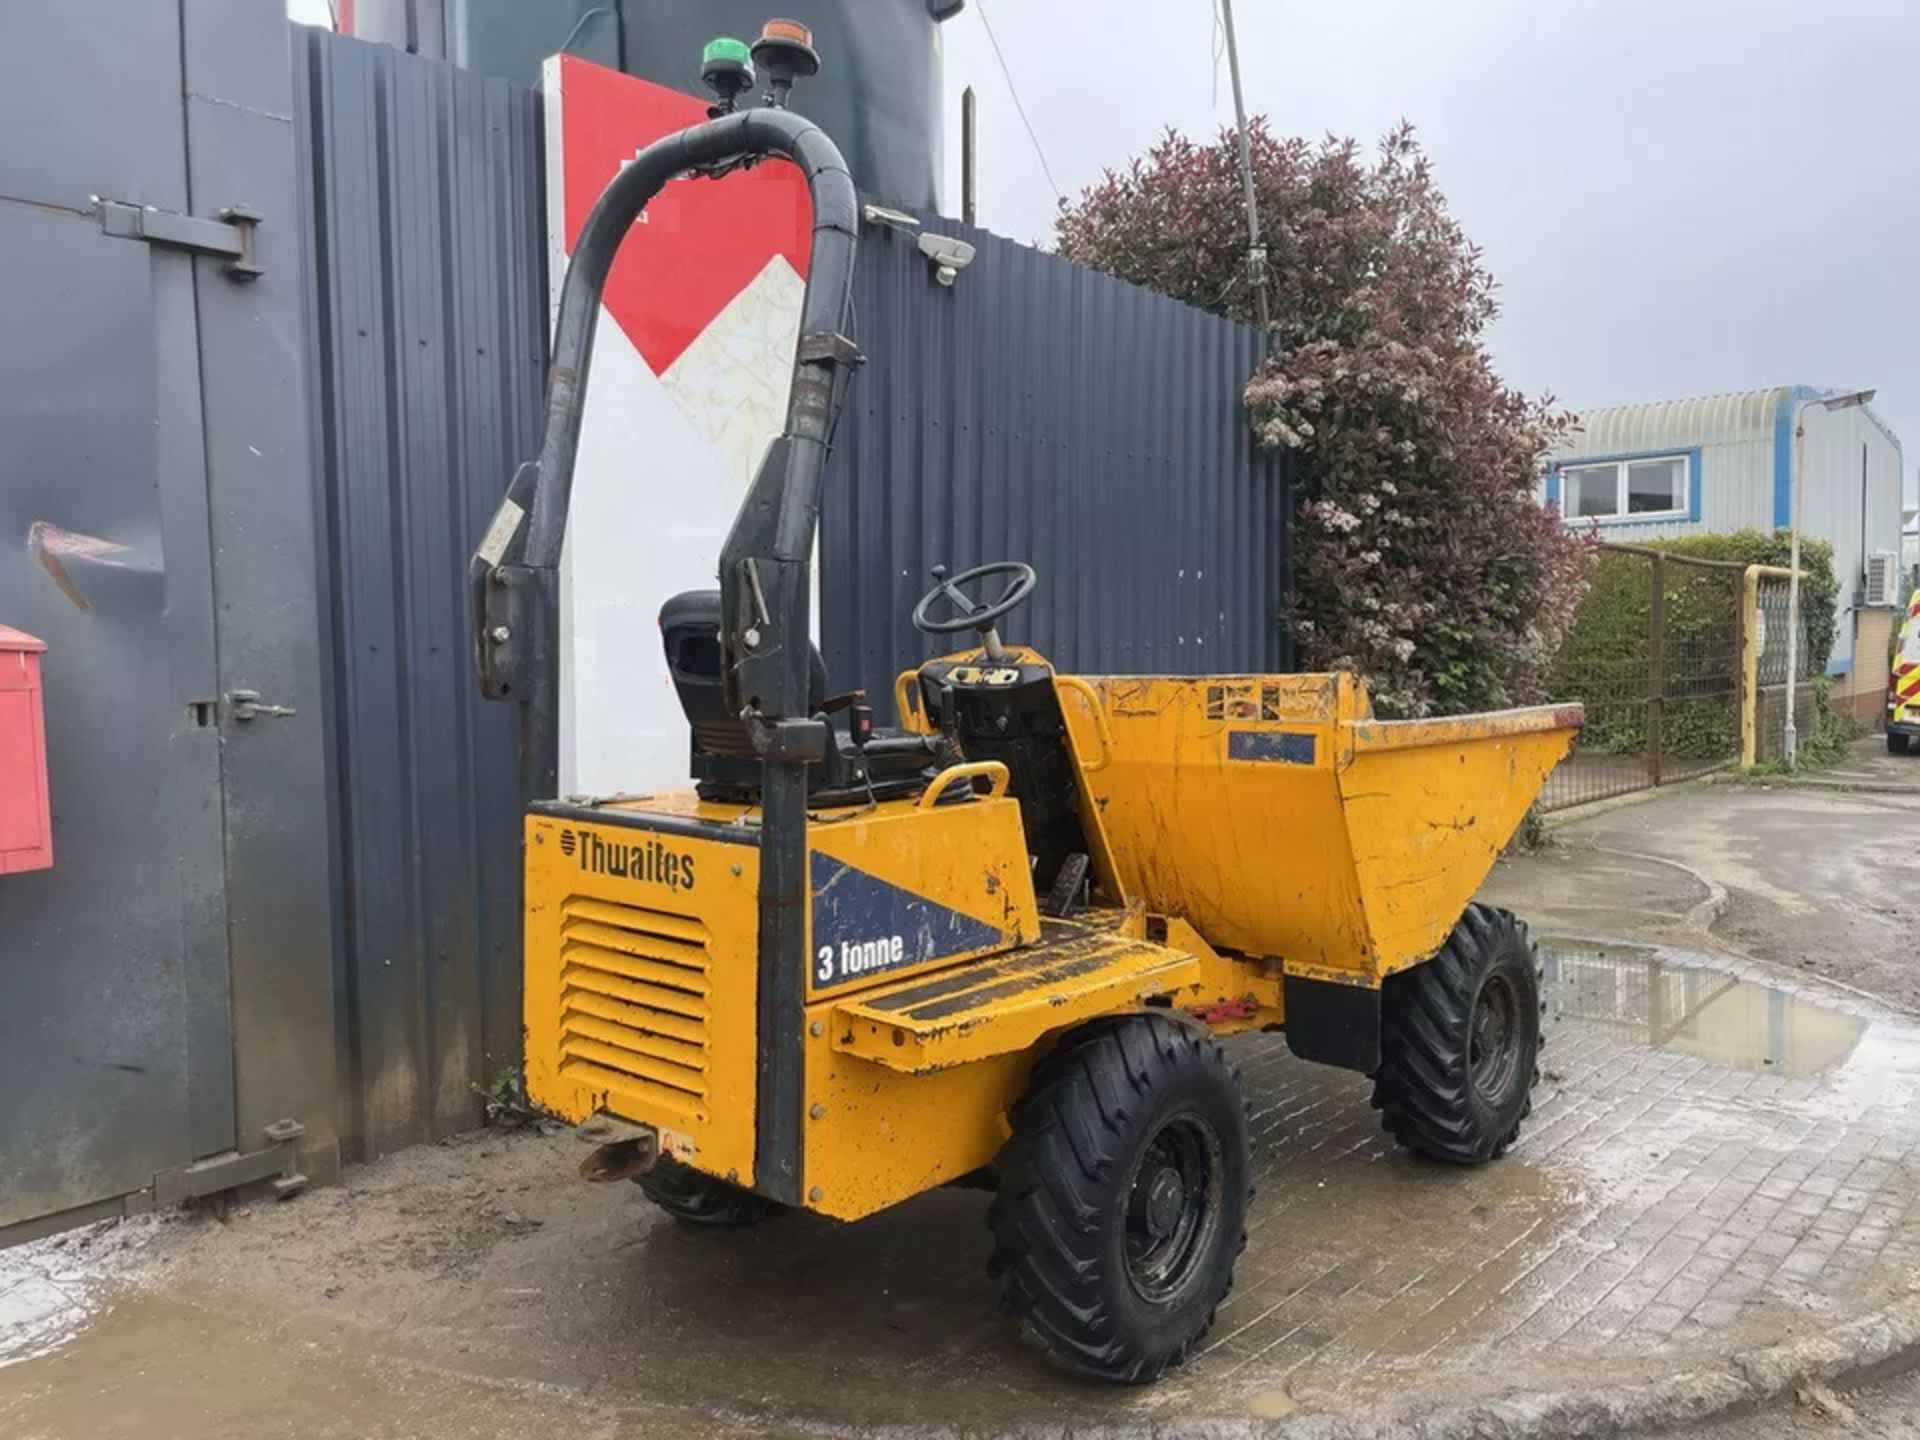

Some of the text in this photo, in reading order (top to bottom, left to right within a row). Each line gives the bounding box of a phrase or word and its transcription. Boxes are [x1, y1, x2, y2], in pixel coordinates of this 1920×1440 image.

[577, 830, 695, 890] Thwaites
[818, 935, 903, 980] 3 tonne
